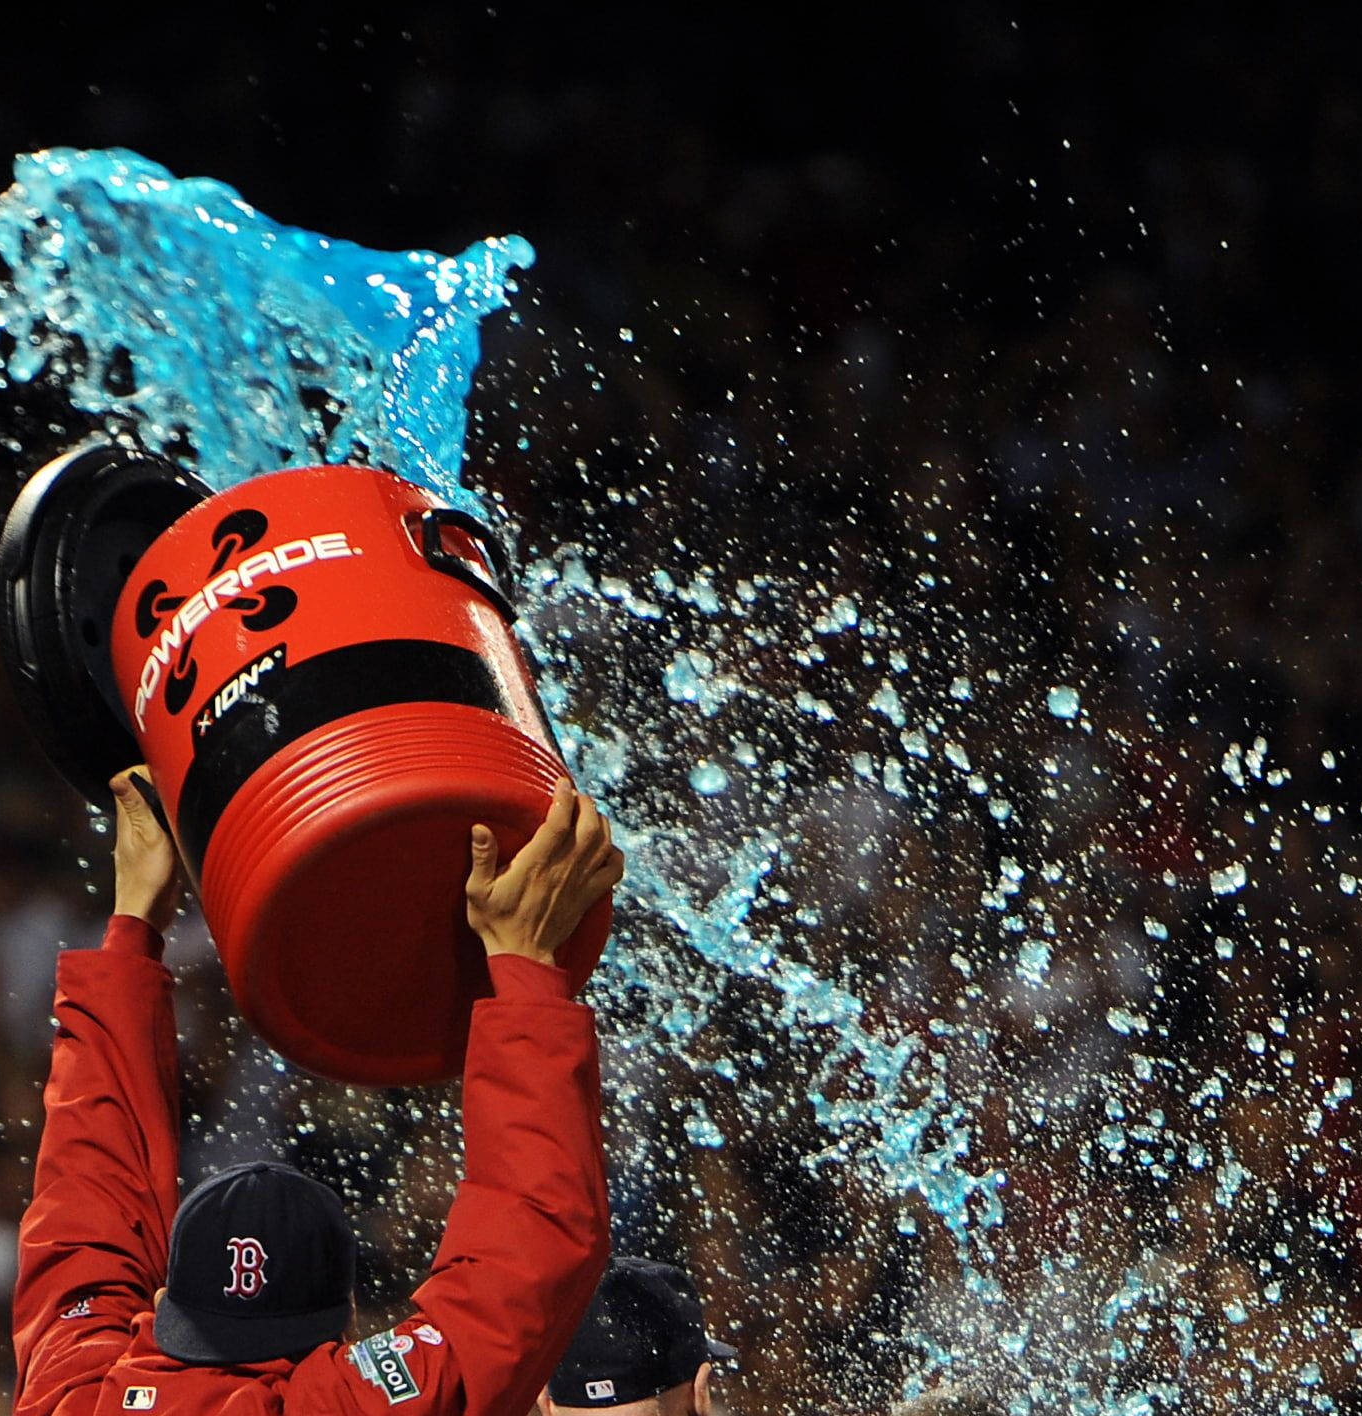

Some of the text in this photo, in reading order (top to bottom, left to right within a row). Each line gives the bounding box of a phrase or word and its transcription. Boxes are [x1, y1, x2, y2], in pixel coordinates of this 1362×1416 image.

[135, 532, 353, 733] POWERADE
[223, 1237, 269, 1300] B
[381, 1359, 408, 1392] 100
